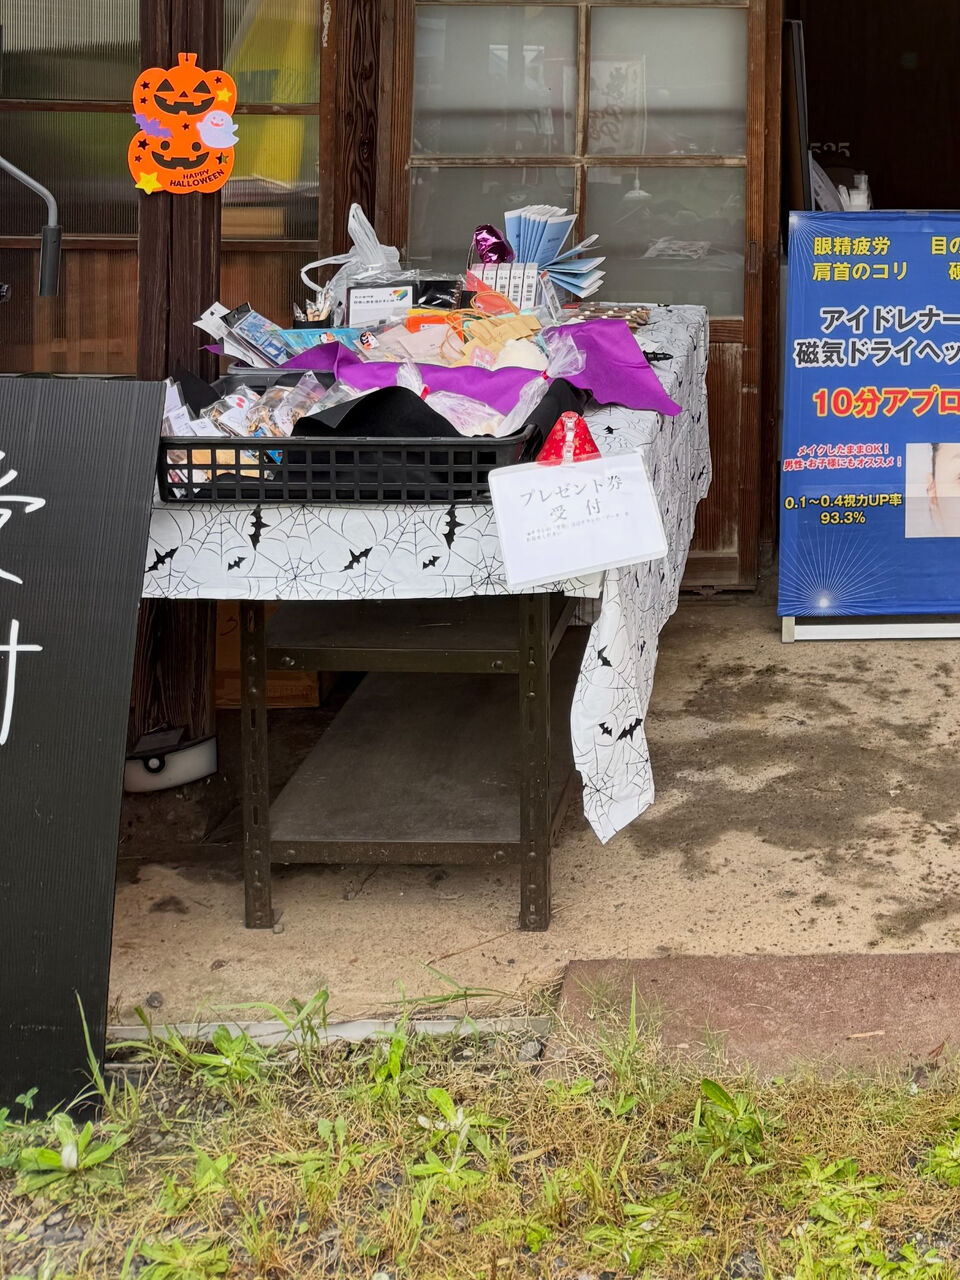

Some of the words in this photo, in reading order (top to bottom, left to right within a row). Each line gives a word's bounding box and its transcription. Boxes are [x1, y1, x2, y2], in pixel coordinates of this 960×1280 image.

[169, 169, 225, 187] HALLOWEEN
[182, 169, 210, 180] HAPPY
[813, 236, 891, 257] 眼精疲労
[812, 261, 907, 282] 肩首のコリ
[520, 475, 623, 507] プレゼント券
[820, 511, 867, 525] 93.3%
